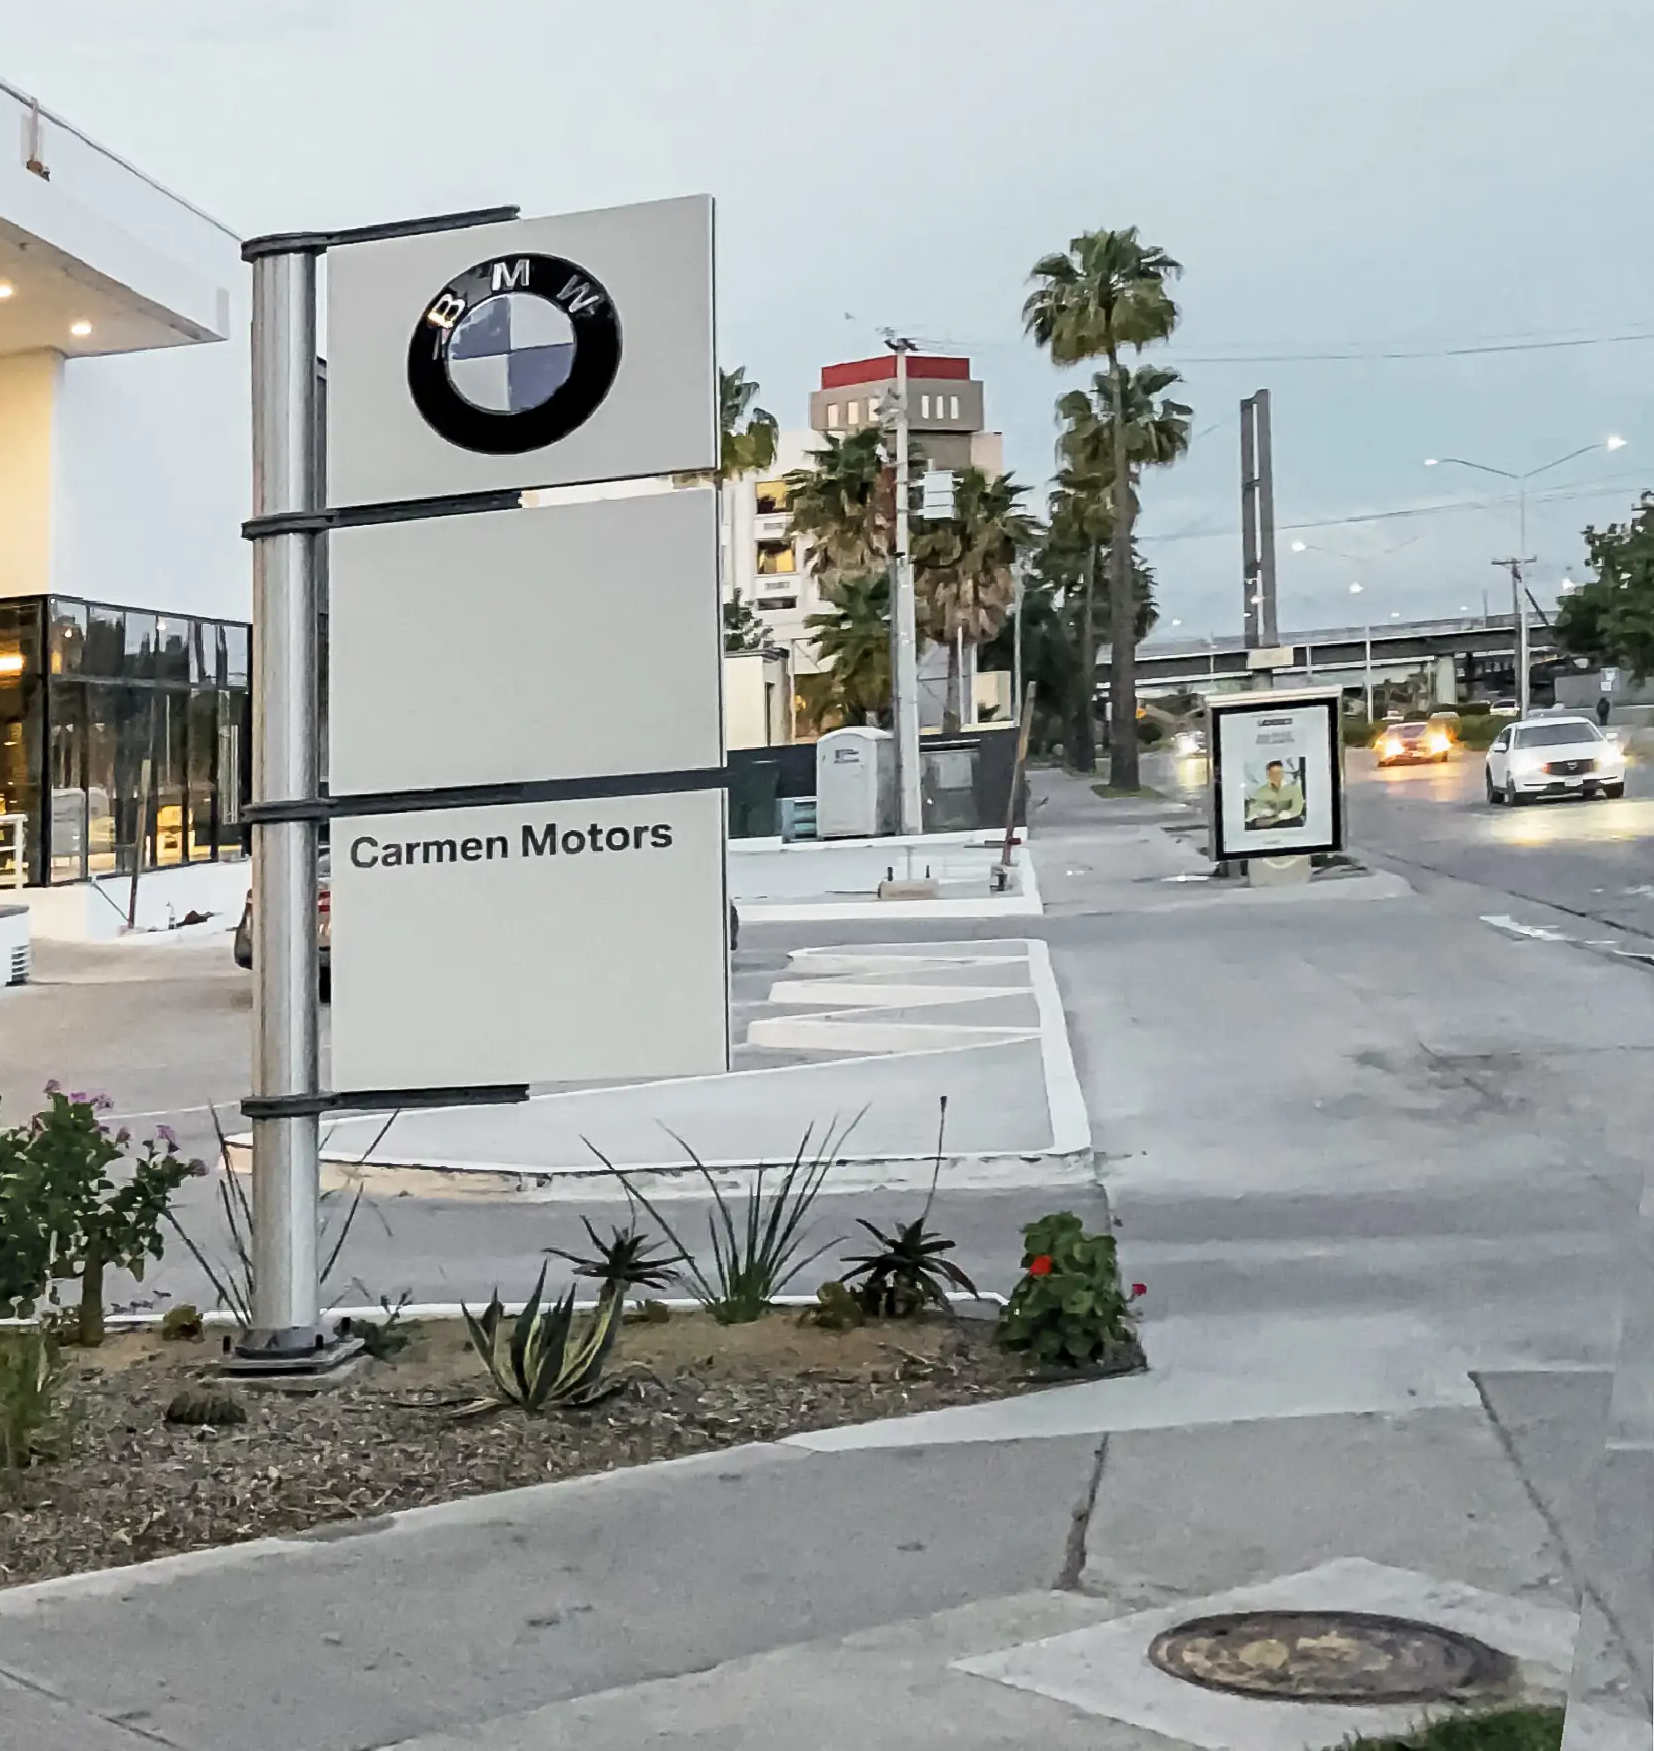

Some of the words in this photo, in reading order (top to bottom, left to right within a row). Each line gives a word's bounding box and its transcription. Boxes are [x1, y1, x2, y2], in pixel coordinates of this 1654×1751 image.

[427, 258, 601, 330] BMW
[349, 835, 509, 869] Carmen
[521, 822, 674, 858] Motors
